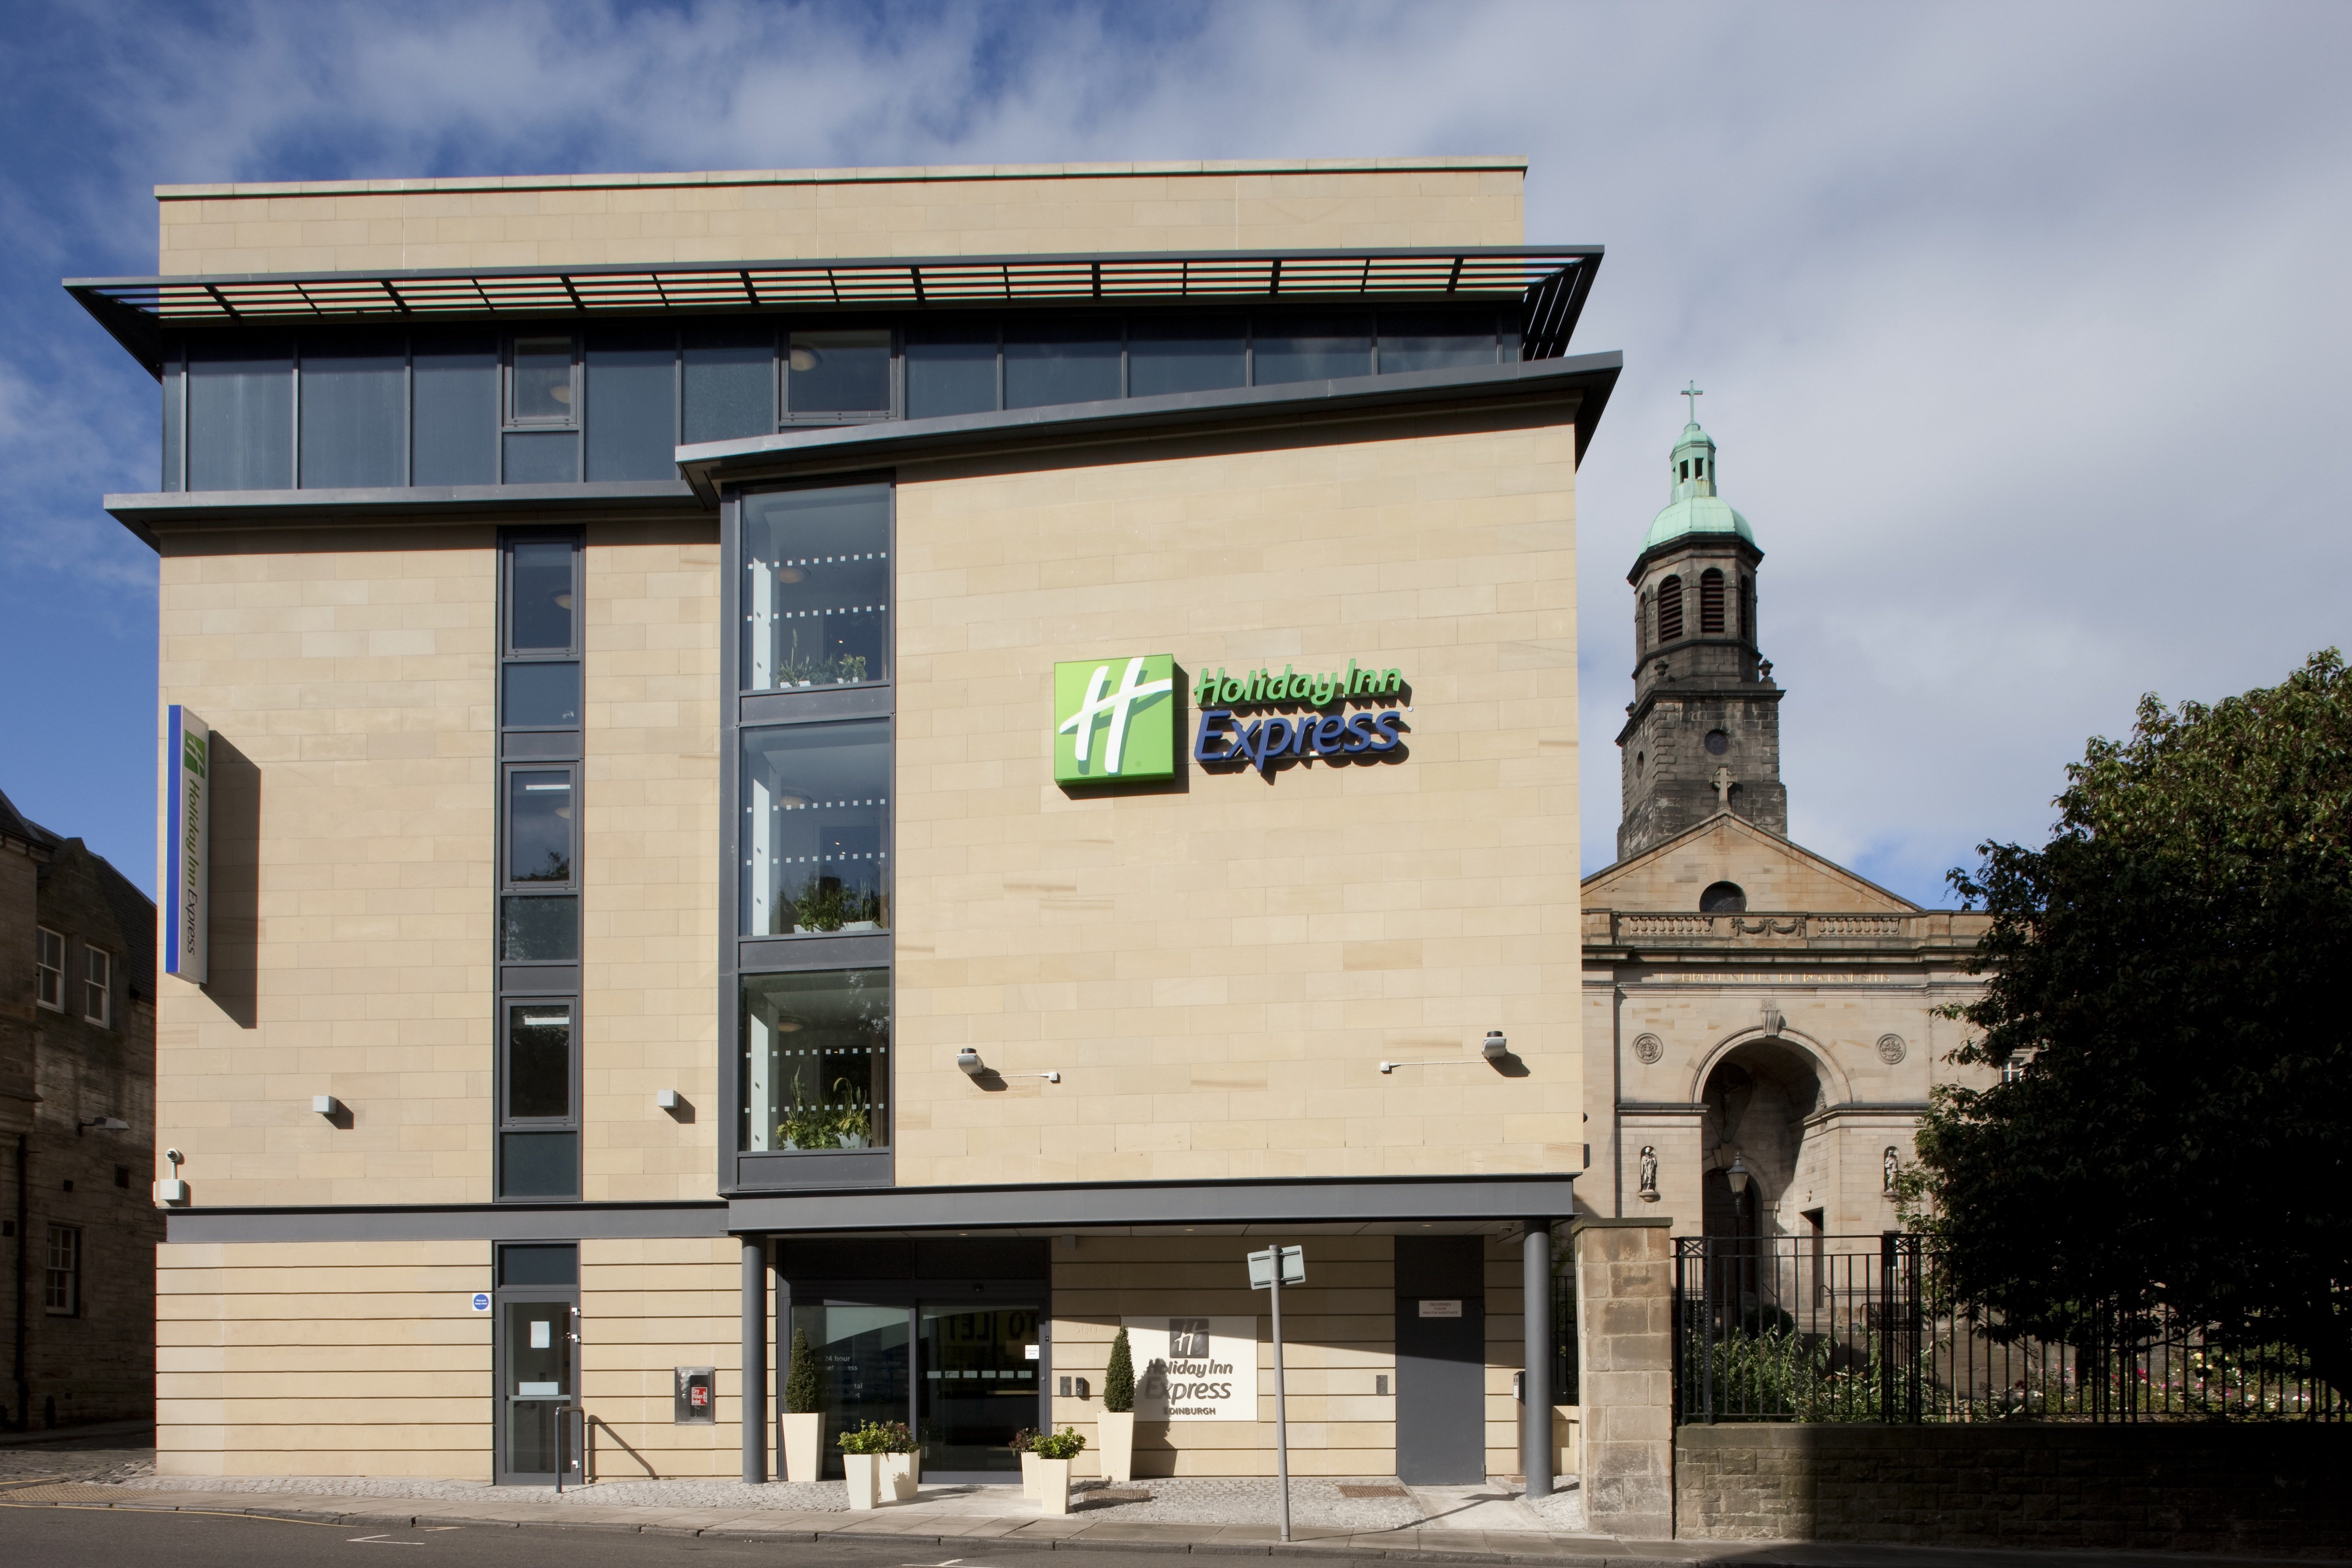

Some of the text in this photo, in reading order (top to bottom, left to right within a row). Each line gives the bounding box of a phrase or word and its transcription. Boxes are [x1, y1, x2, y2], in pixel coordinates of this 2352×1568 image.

[1194, 659, 1401, 708] Holiday Inn
[1194, 710, 1400, 773] Express
[186, 779, 200, 956] Holiday Inn Express
[1672, 972, 1743, 983] CHRISTIANI
[1803, 973, 1854, 983] ROMANI
[1147, 1359, 1233, 1378] Holiday Inn
[1145, 1376, 1232, 1406] Express
[1163, 1407, 1216, 1415] EDINBURGH
